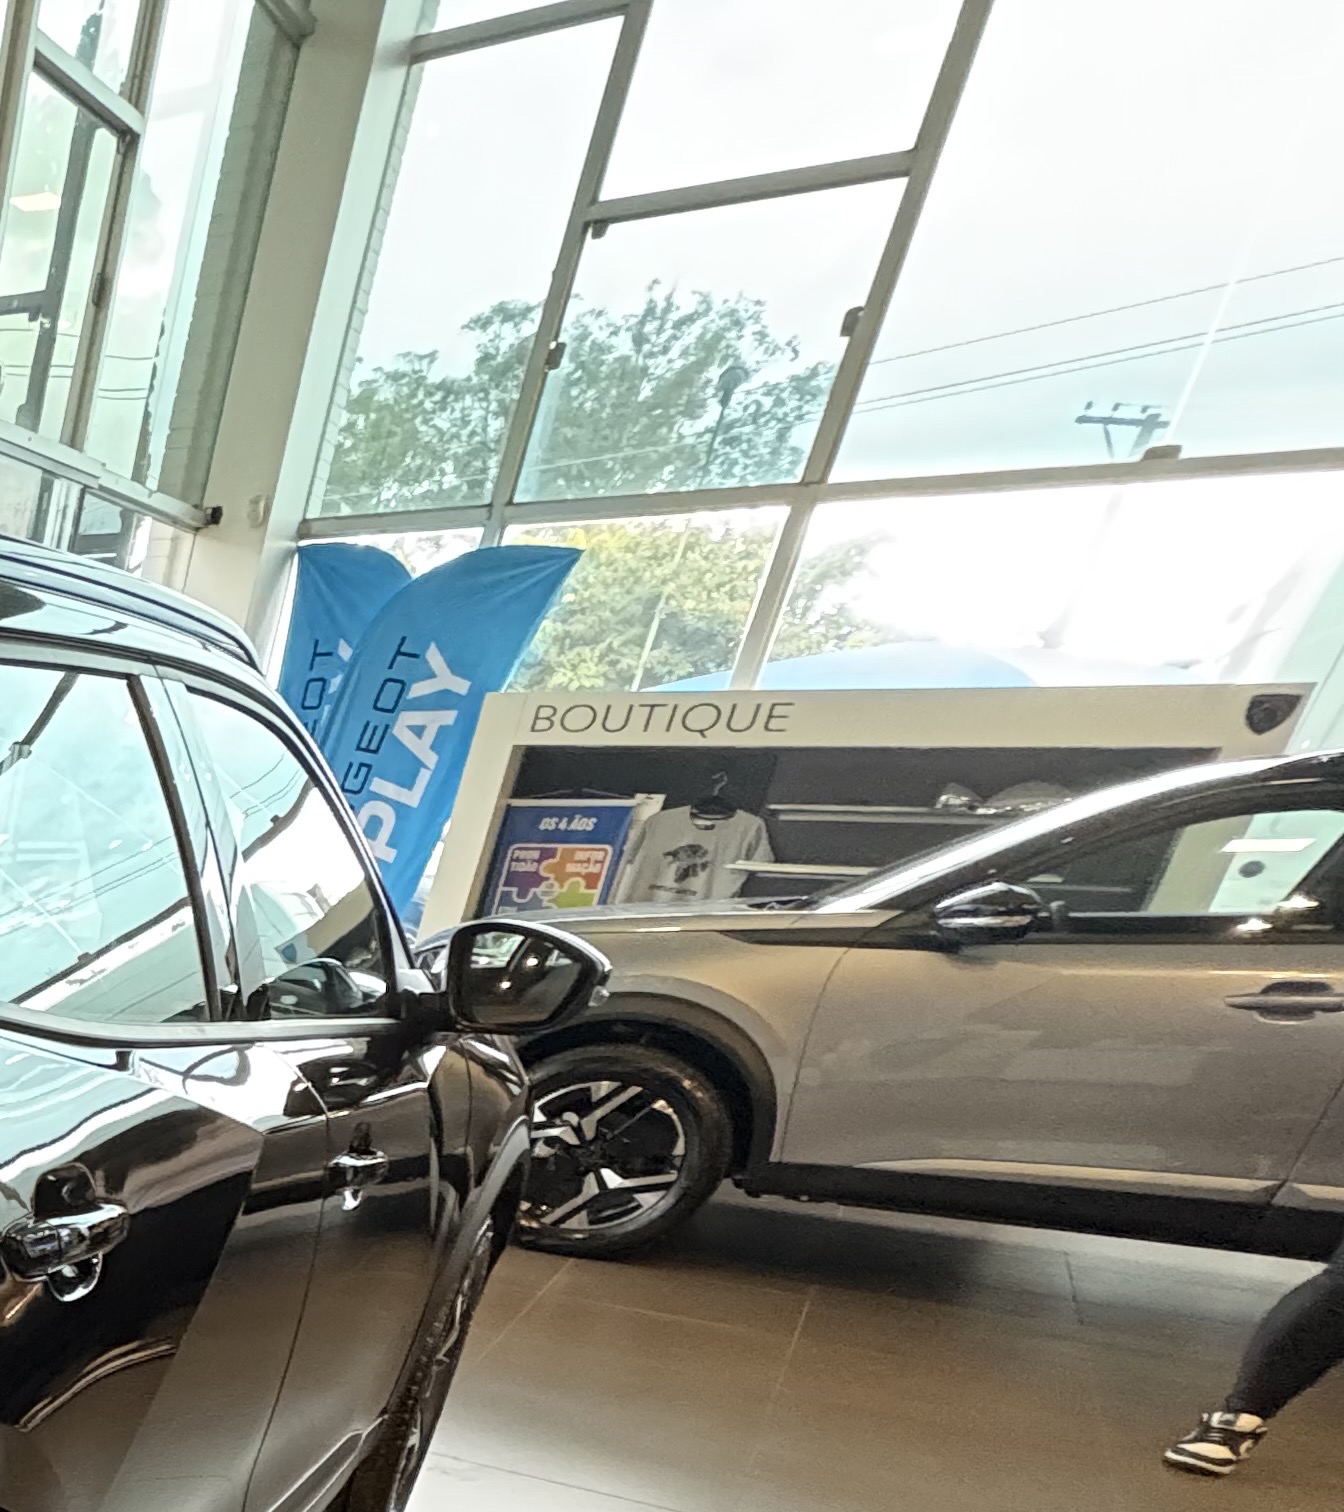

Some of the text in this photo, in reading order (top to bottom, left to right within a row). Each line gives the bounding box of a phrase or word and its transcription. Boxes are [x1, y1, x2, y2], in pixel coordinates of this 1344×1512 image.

[341, 636, 421, 811] GEOT
[357, 641, 472, 863] PLAY
[529, 701, 796, 739] BOUTIQUE
